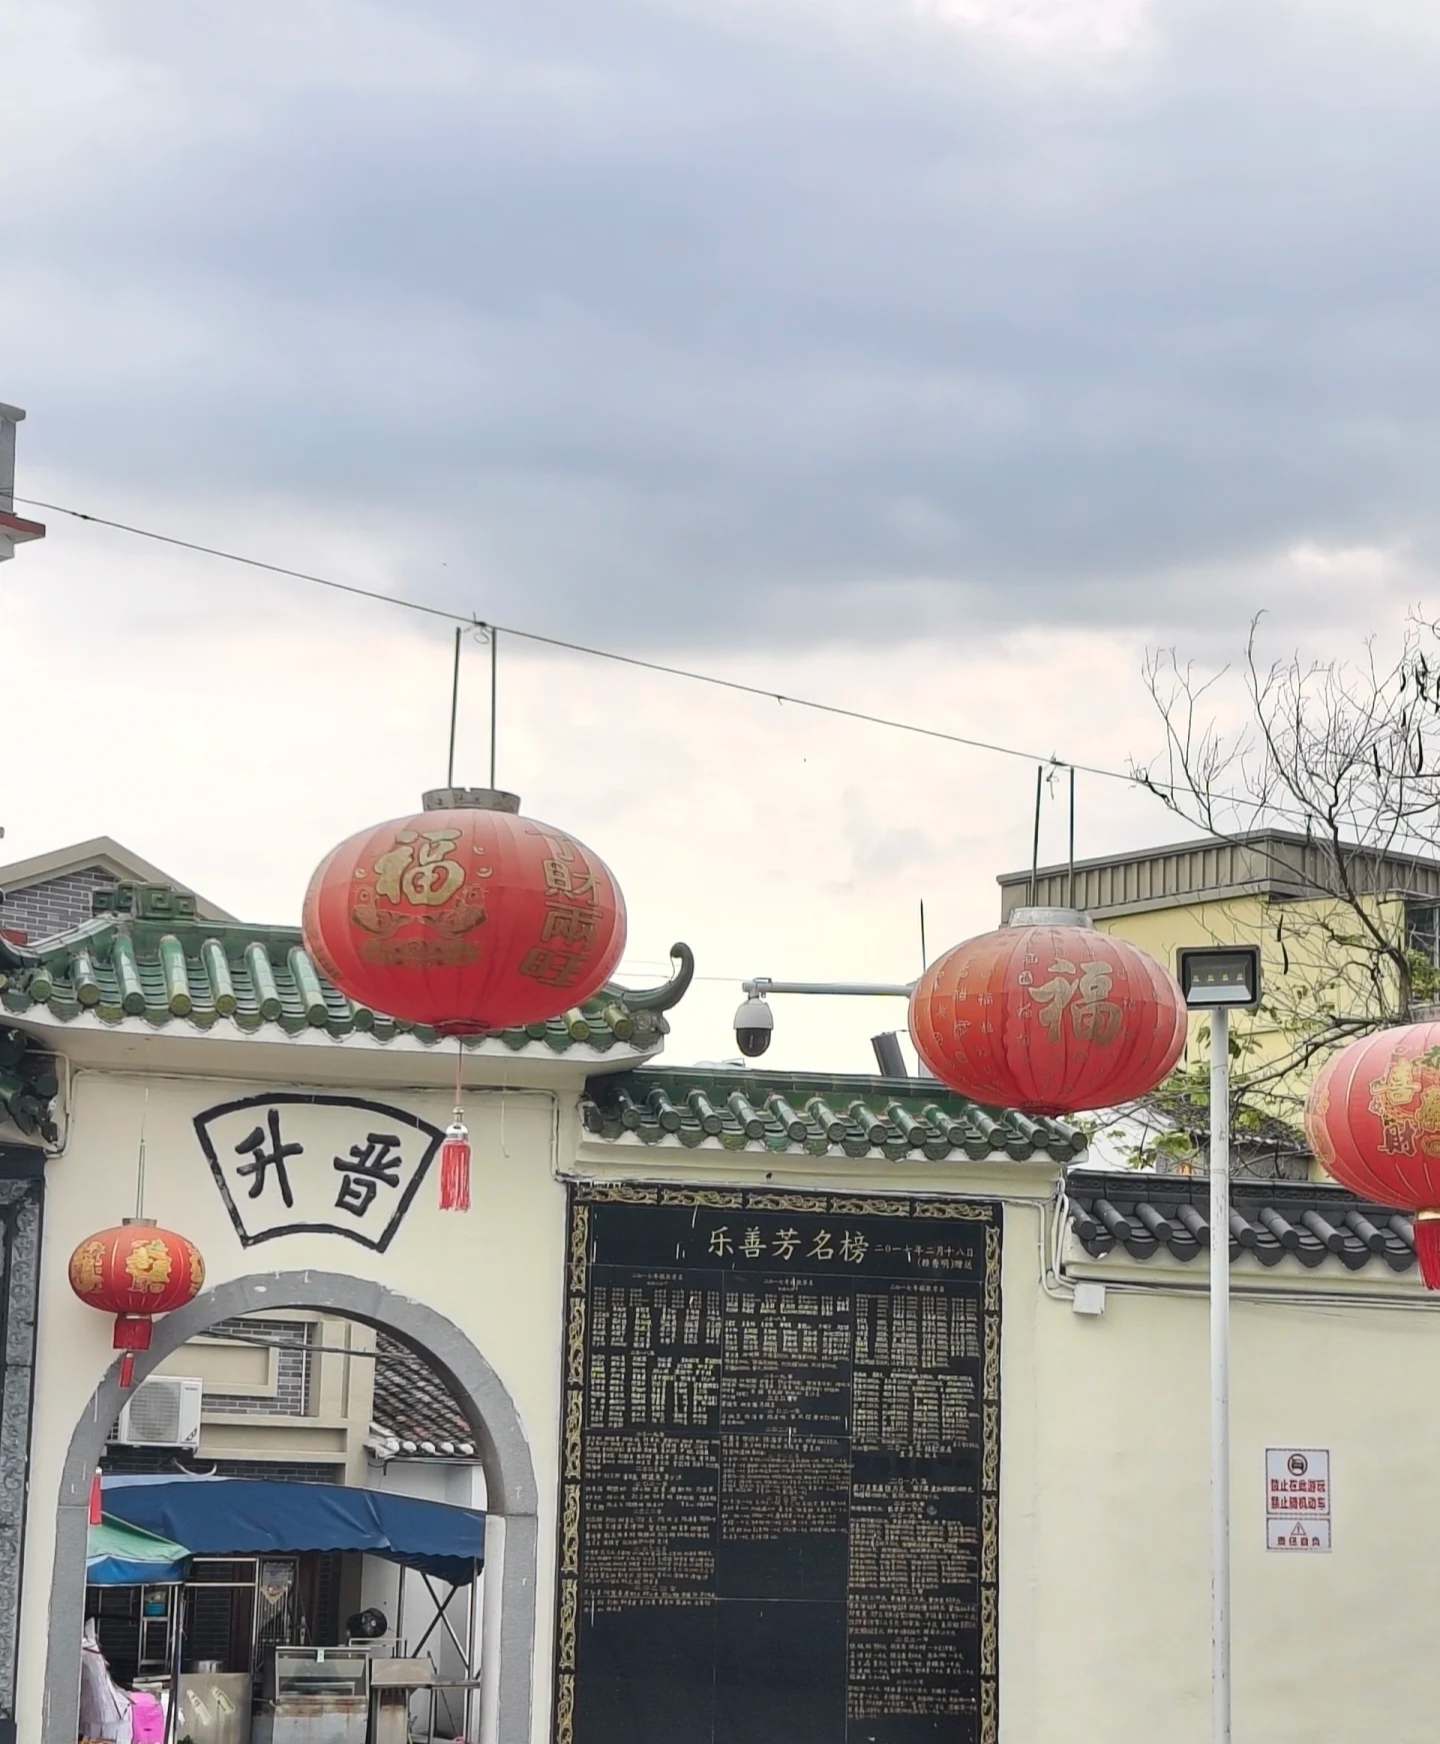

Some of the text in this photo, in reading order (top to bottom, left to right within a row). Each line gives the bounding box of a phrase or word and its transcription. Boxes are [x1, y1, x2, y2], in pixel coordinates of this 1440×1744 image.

[1028, 957, 1123, 1047] 福
[707, 1225, 869, 1264] 乐善芳名榜
